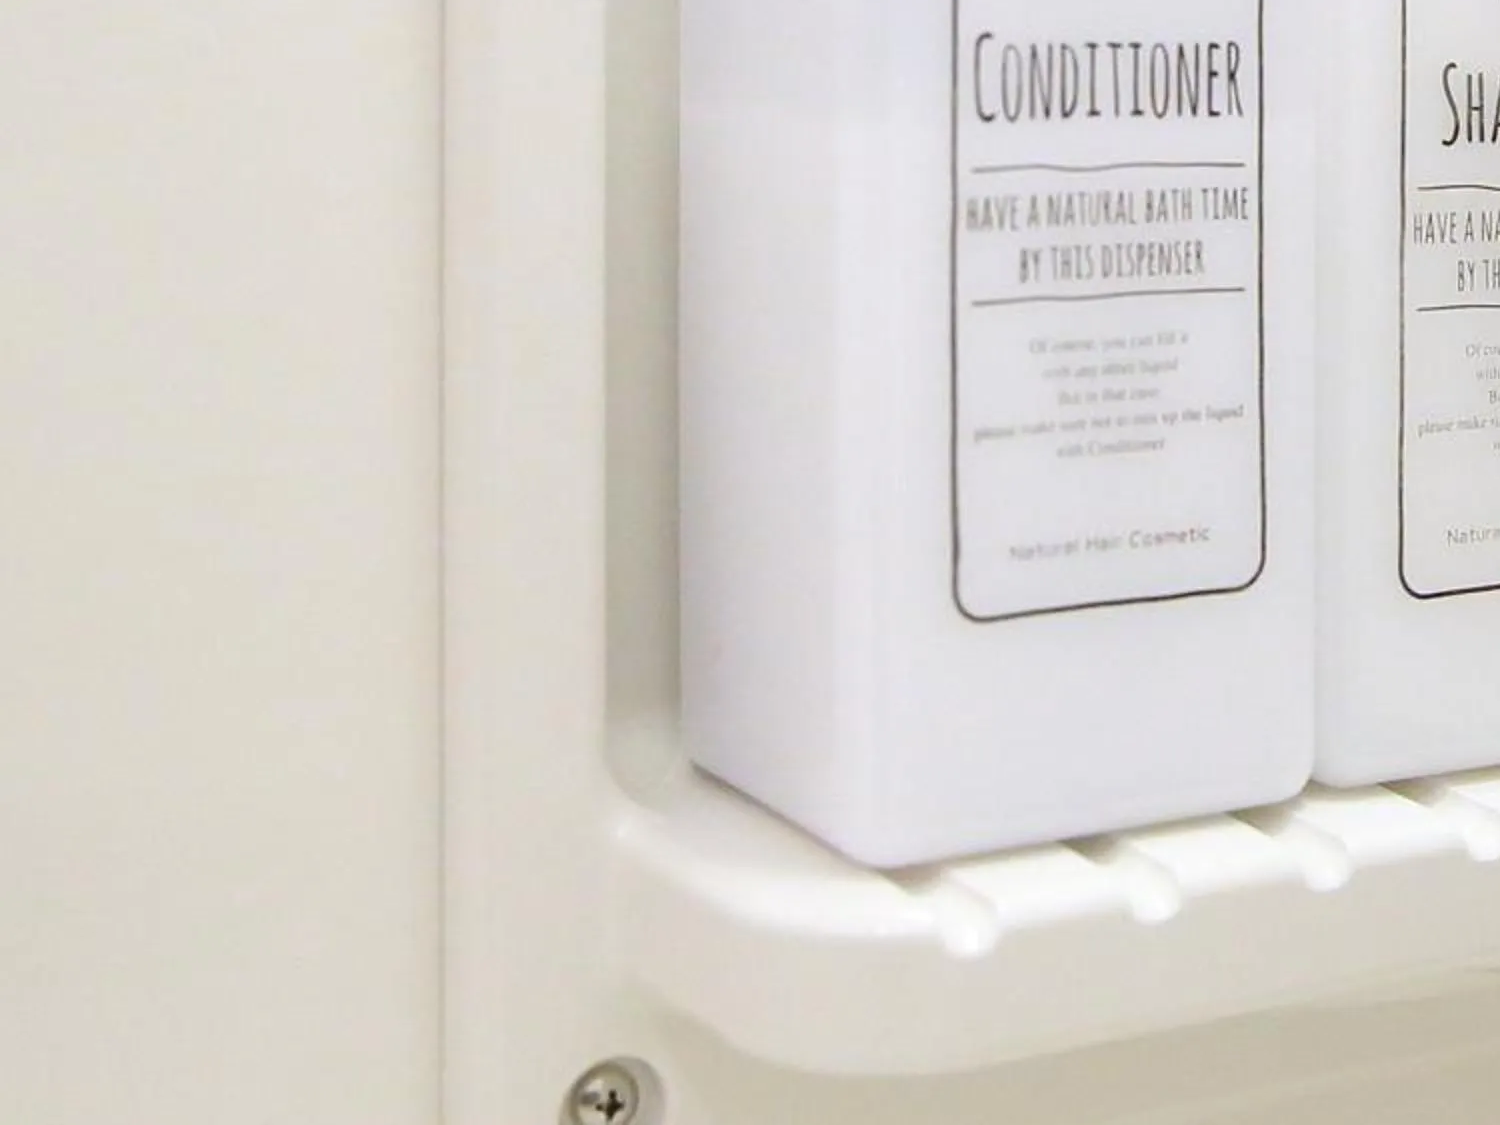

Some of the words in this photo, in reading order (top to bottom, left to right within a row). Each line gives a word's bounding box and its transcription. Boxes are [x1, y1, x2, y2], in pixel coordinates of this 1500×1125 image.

[973, 31, 1245, 124] CONDITIONER
[966, 196, 1018, 232] HAVE
[1027, 195, 1040, 228] A
[1046, 191, 1137, 227] NATURAL
[1145, 189, 1193, 223] BATH
[1201, 186, 1250, 221] TIME
[1414, 211, 1457, 245] HAVE
[1464, 212, 1474, 243] A
[1018, 248, 1041, 284] BY
[1050, 244, 1094, 280] THIS
[1101, 240, 1205, 278] DISPENSER
[1457, 260, 1476, 292] BY
